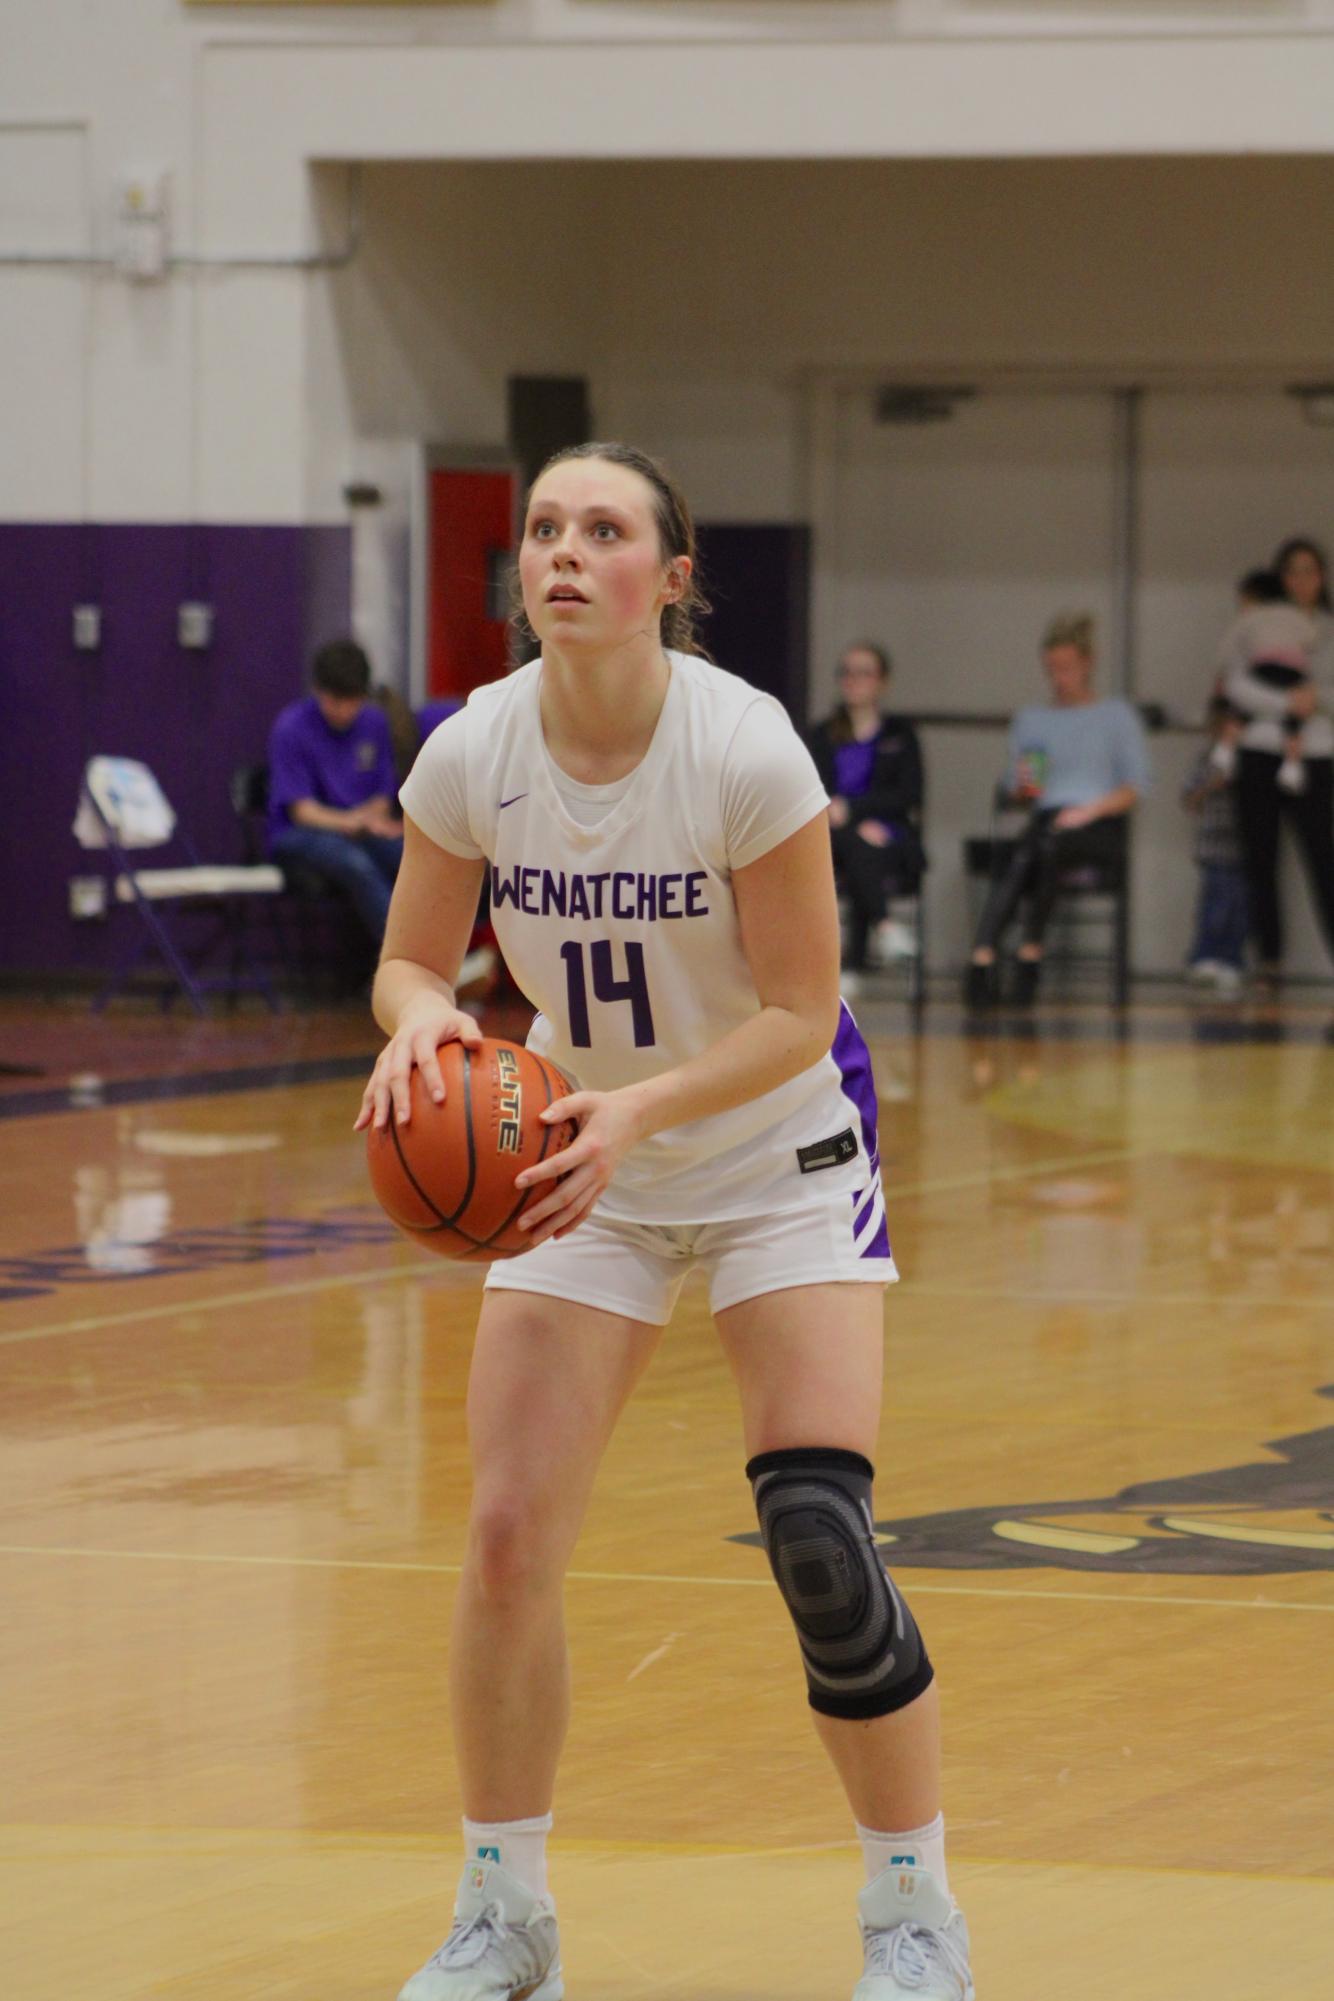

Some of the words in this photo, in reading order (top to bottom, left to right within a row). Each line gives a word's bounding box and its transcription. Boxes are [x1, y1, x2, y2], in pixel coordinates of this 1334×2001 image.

[492, 865, 709, 922] WENATCHEE
[560, 939, 656, 1048] 14
[497, 1048, 519, 1153] ELITE
